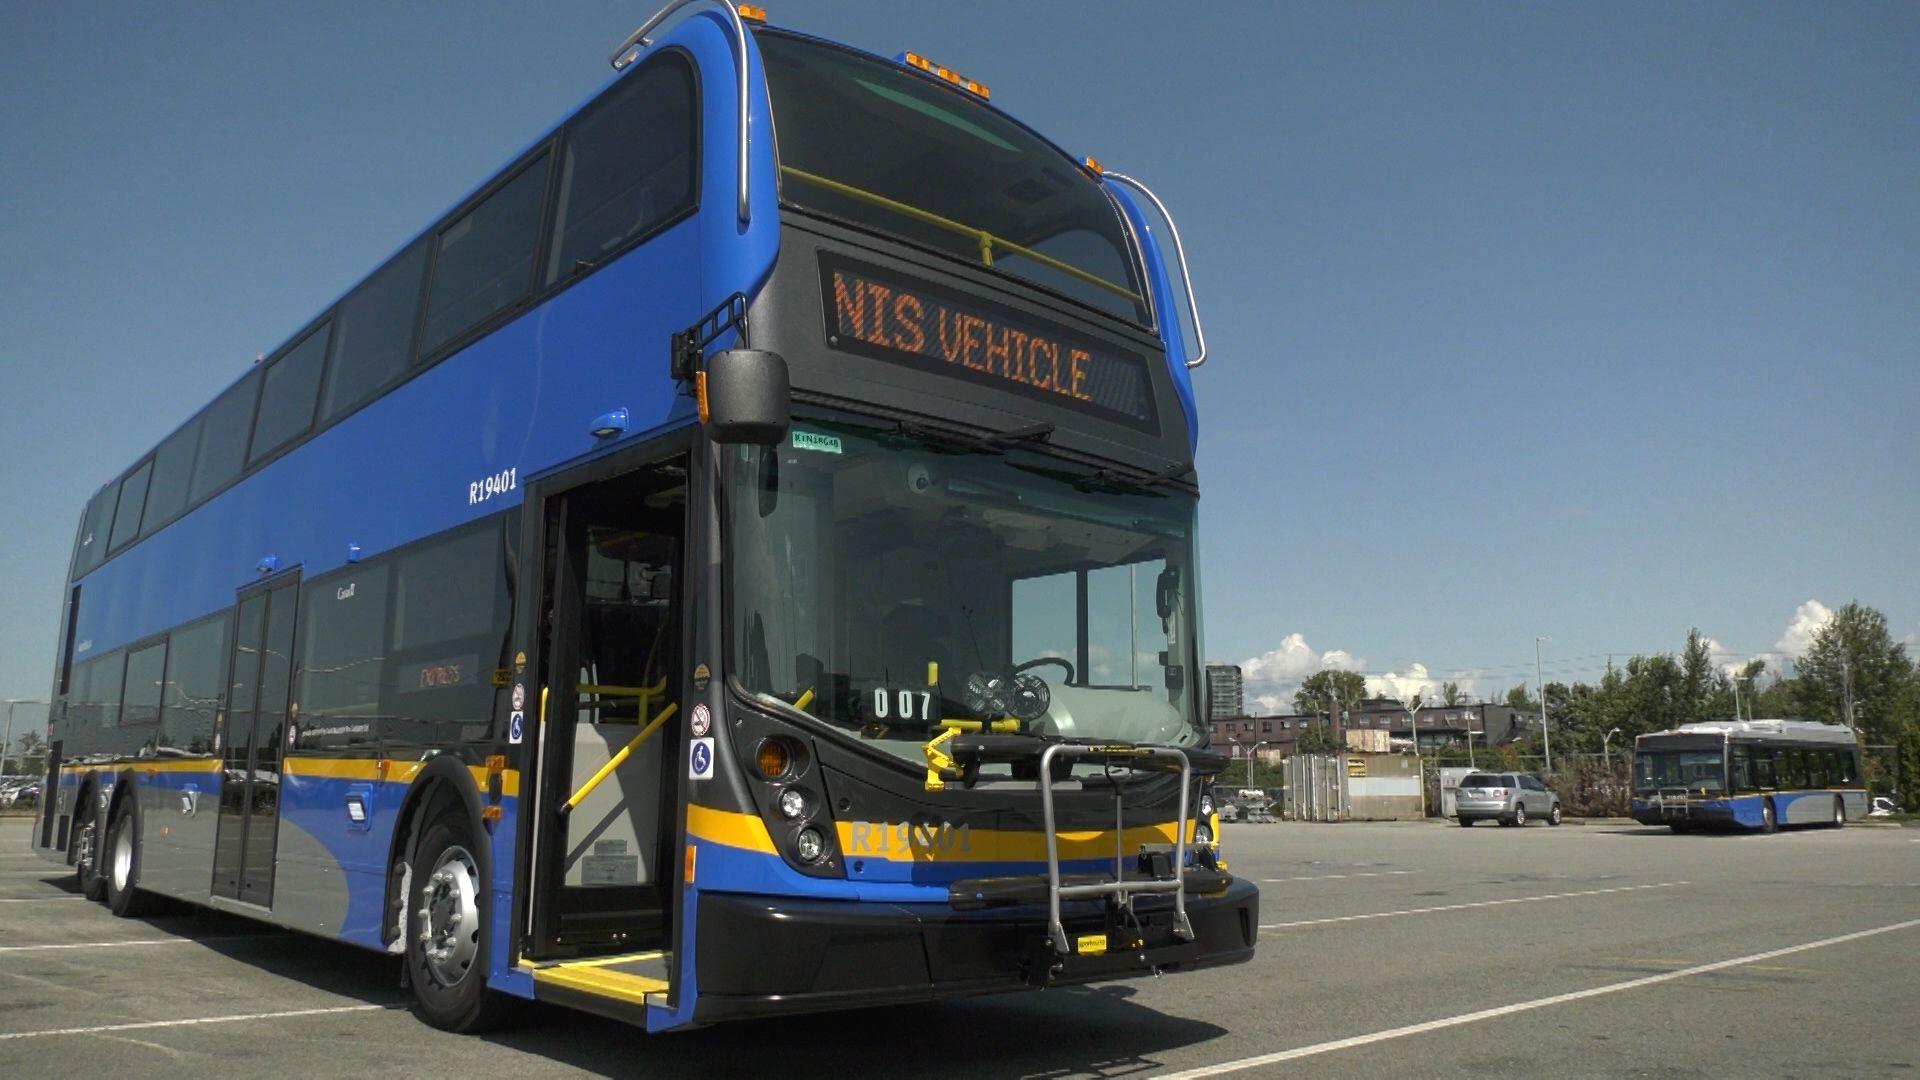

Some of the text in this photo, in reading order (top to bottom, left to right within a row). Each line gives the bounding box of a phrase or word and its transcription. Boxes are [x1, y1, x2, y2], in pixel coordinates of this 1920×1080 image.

[834, 272, 1091, 401] NIS VEHICLE
[469, 467, 517, 505] R19401
